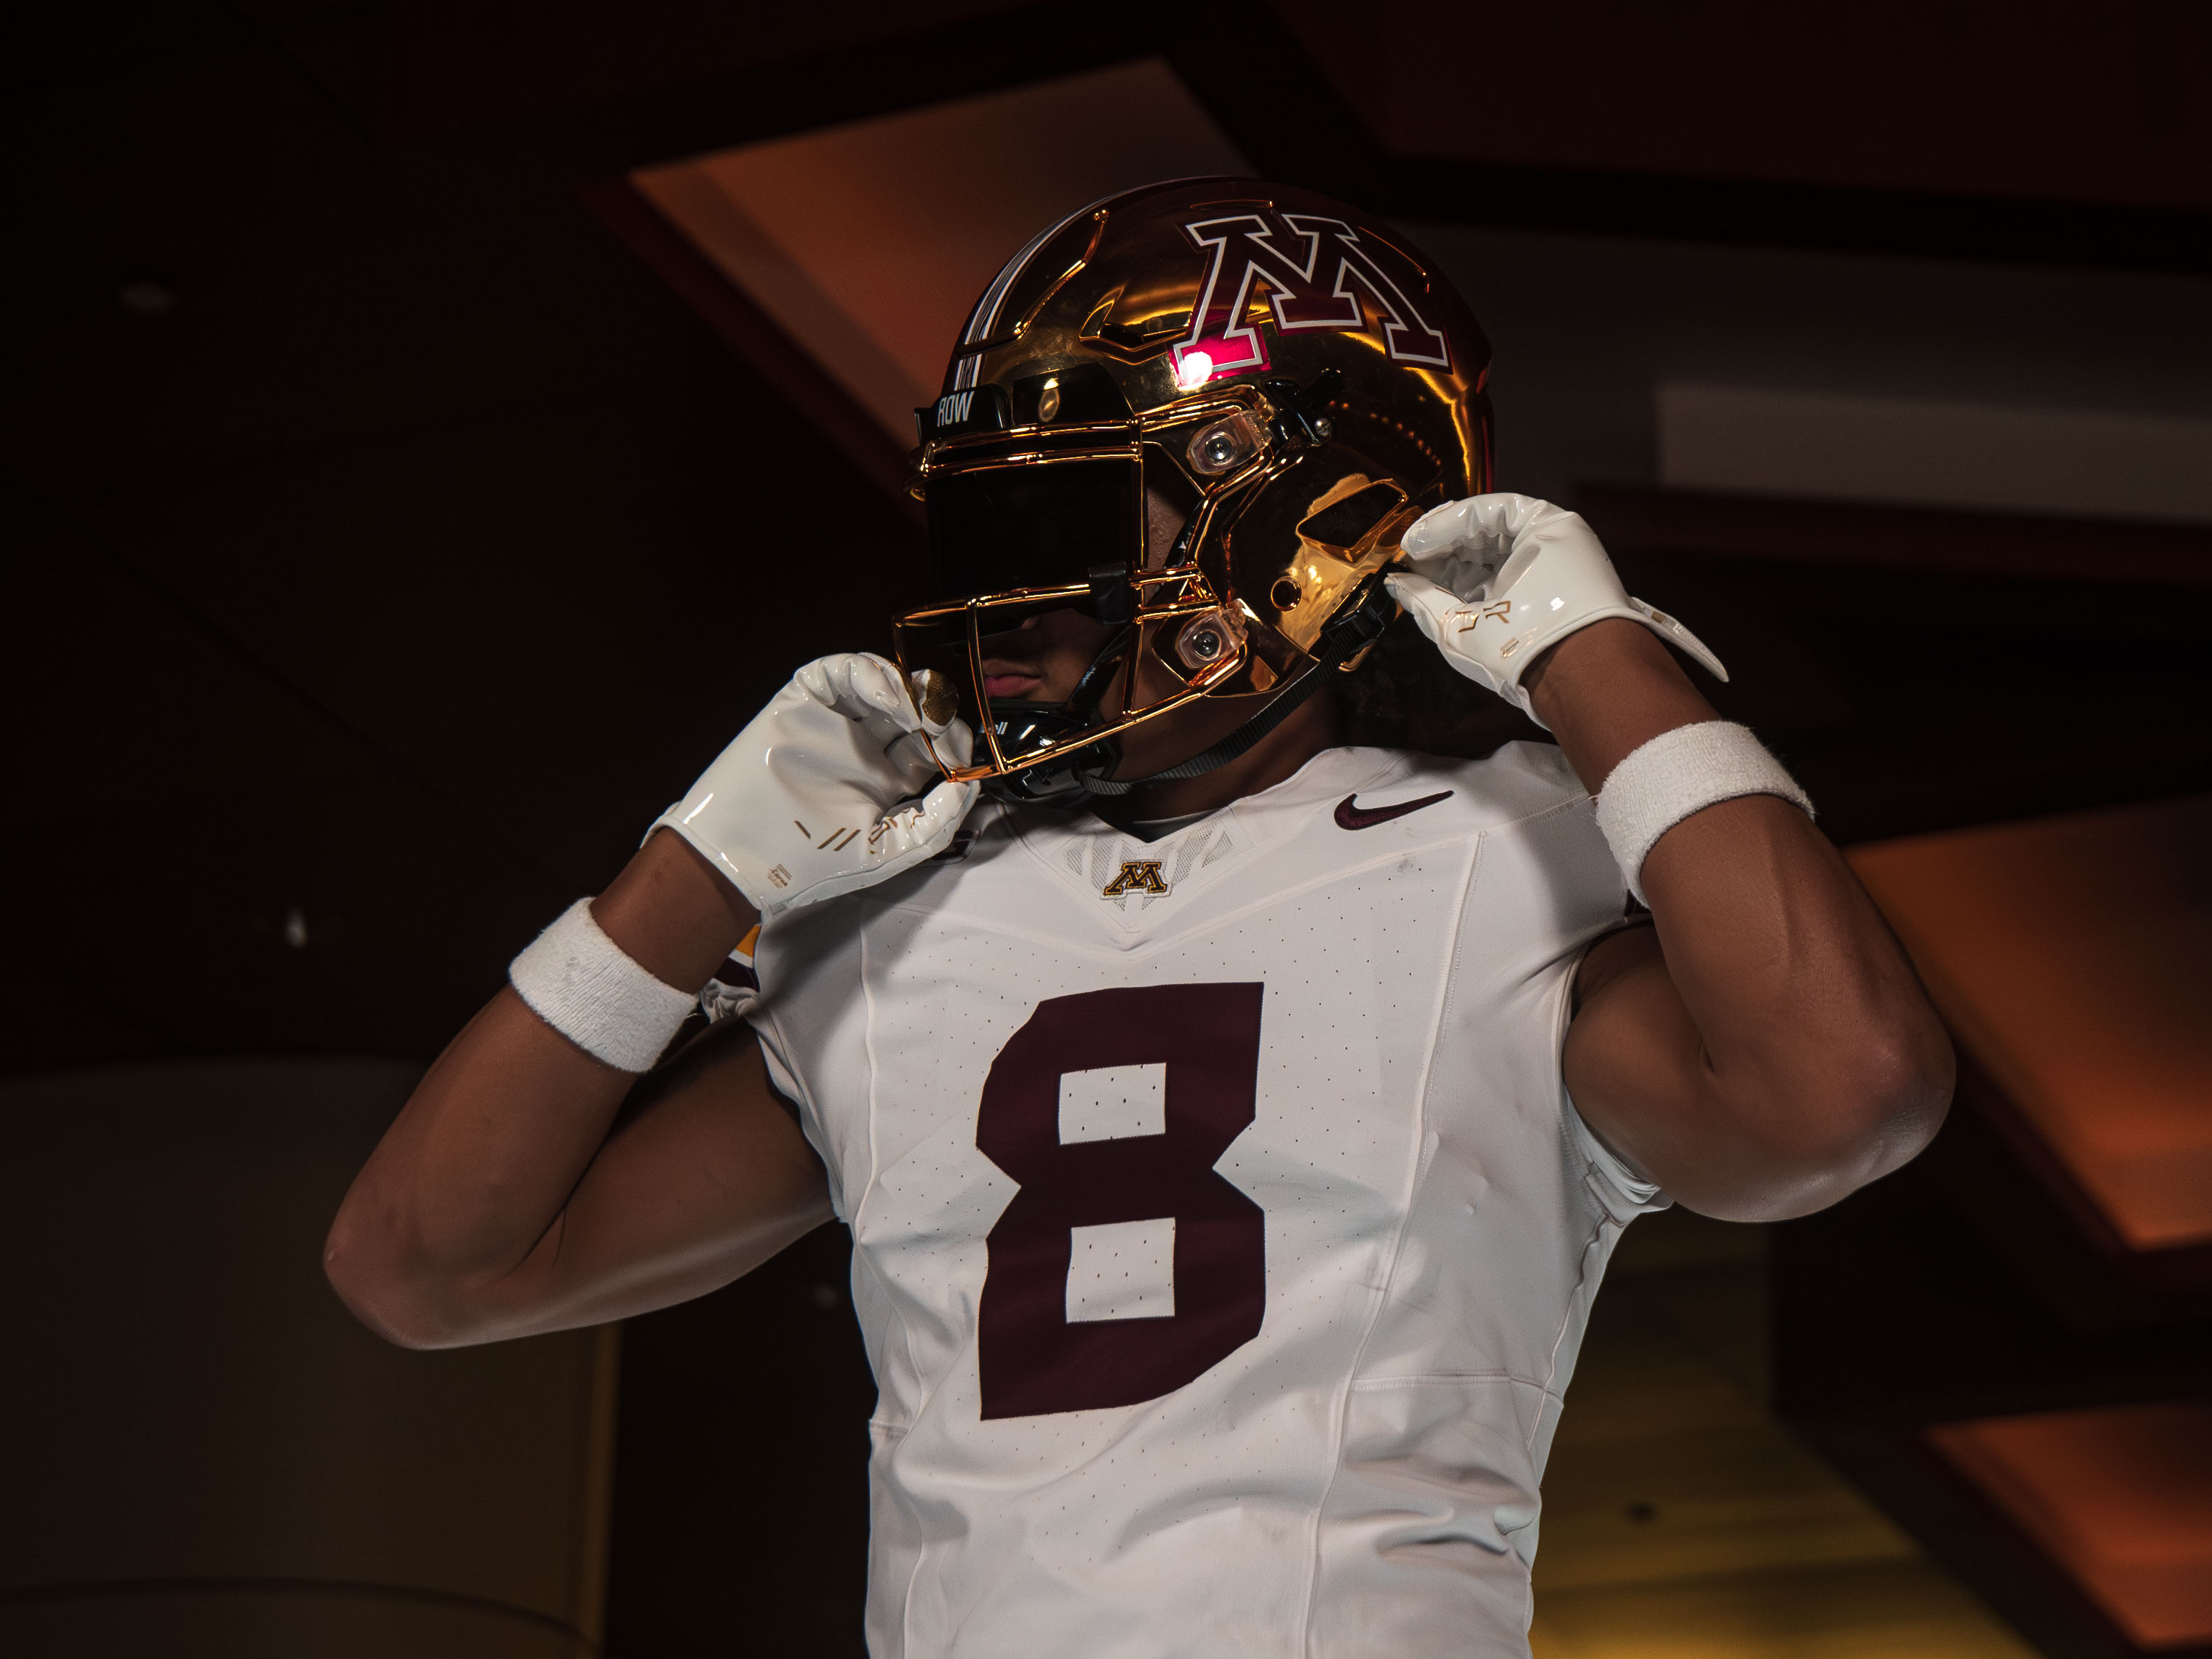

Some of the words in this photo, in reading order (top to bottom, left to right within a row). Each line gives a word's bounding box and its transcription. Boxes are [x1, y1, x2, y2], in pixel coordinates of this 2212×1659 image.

[1169, 213, 1453, 386] M
[937, 391, 975, 427] ROW
[1103, 861, 1167, 896] M
[975, 982, 1266, 1420] 8
